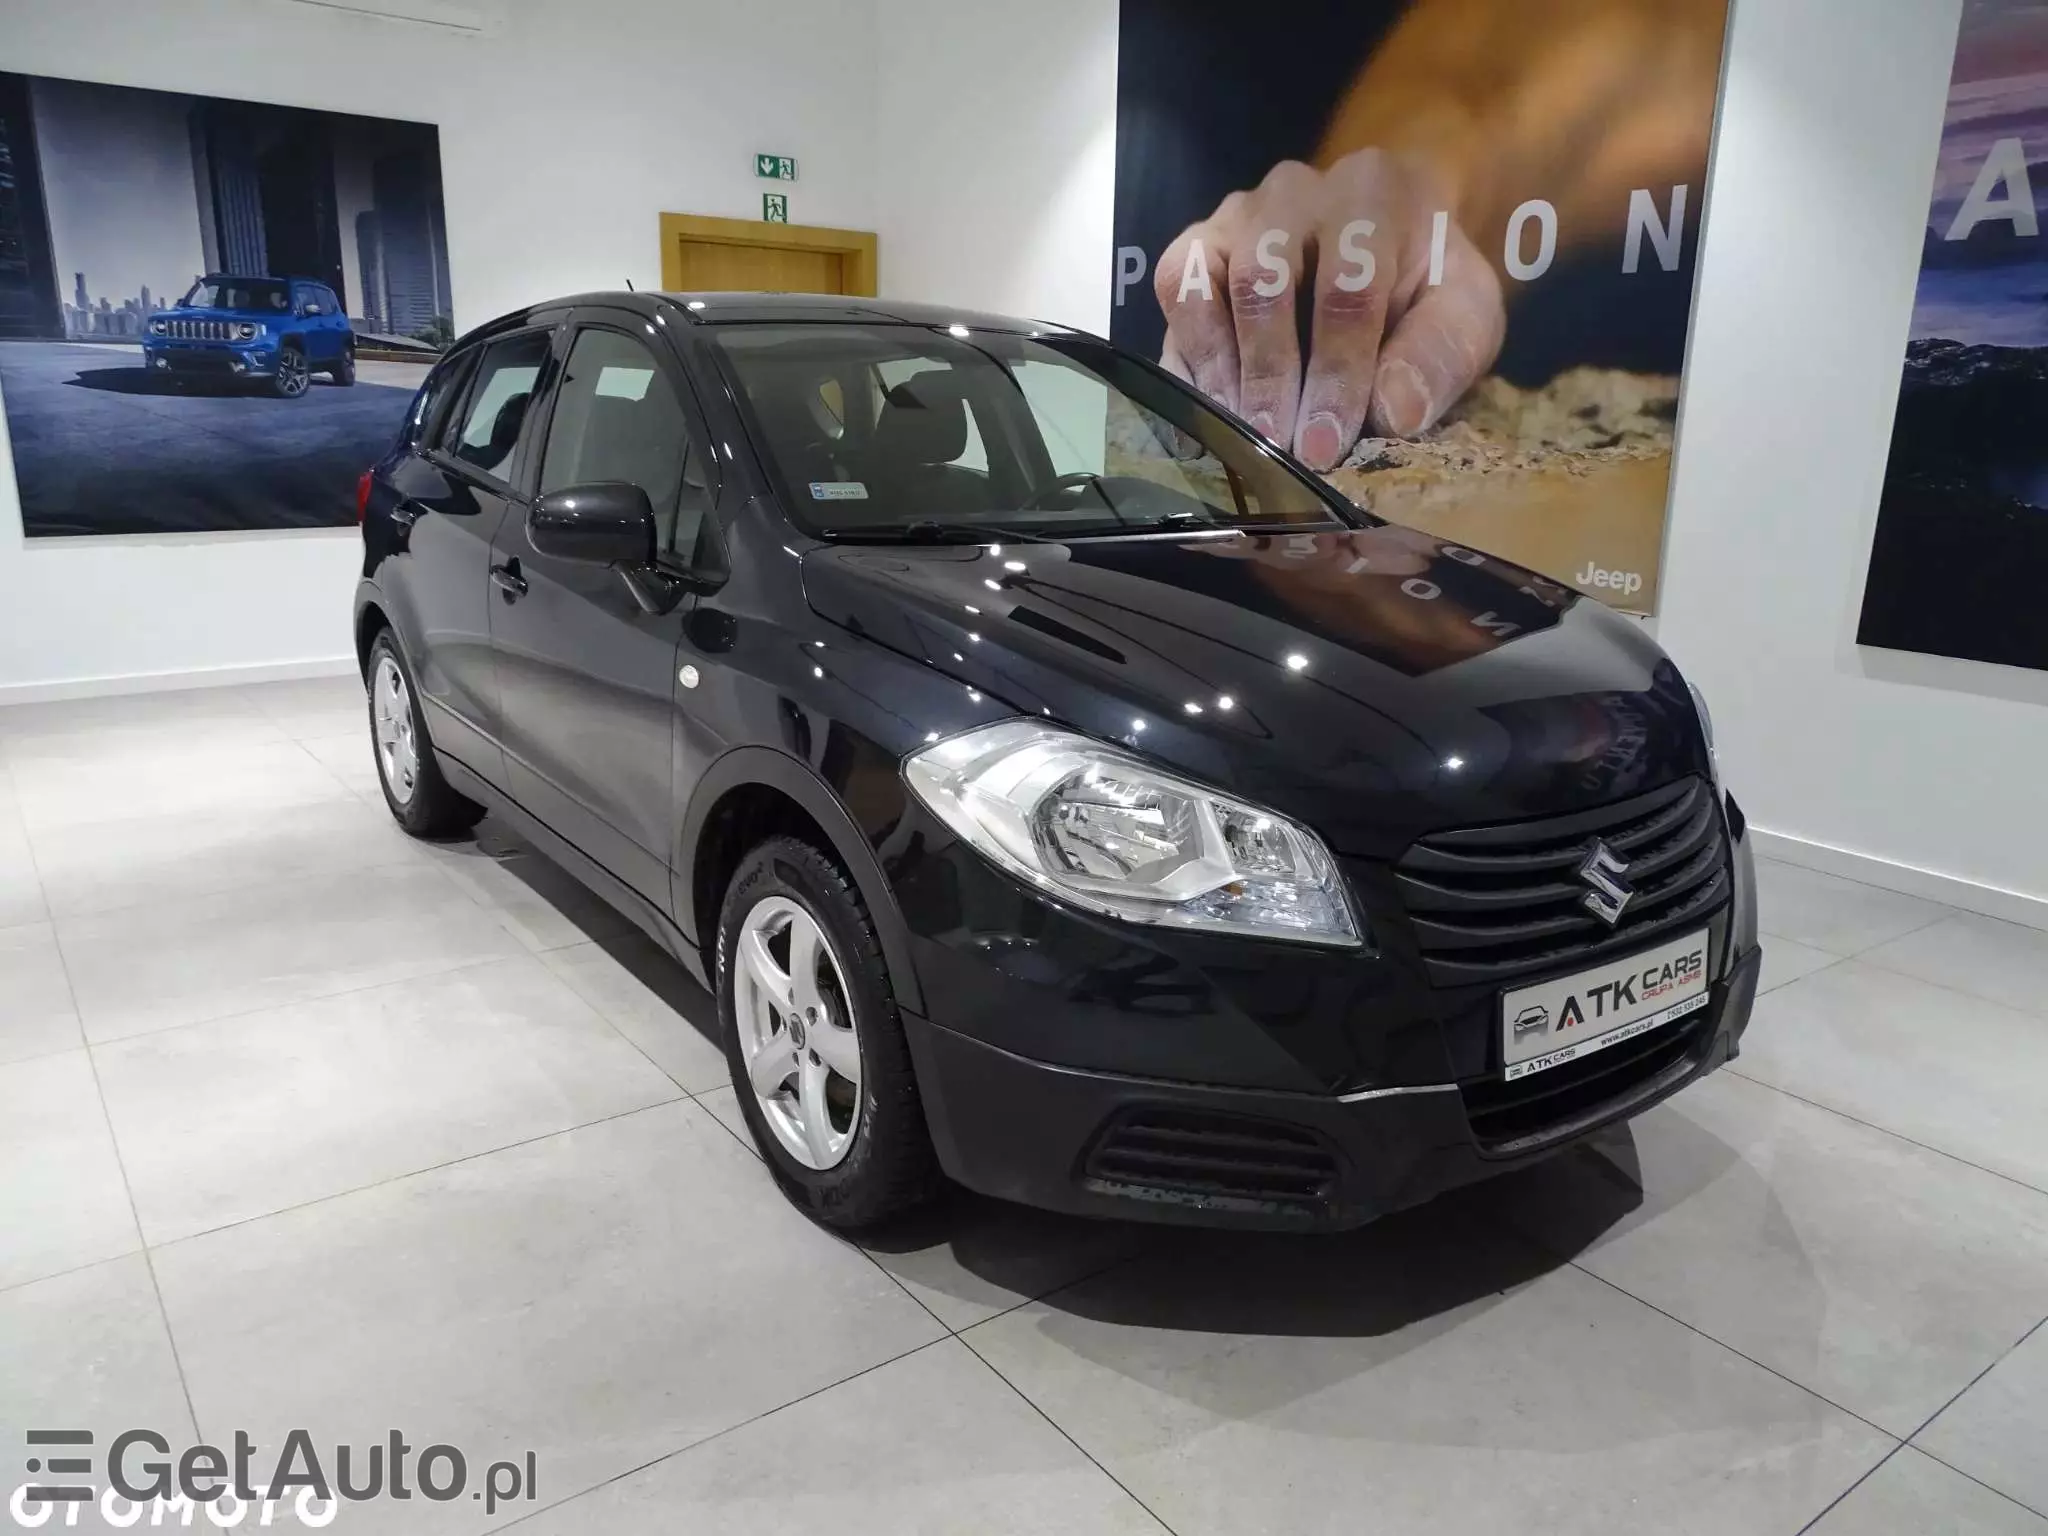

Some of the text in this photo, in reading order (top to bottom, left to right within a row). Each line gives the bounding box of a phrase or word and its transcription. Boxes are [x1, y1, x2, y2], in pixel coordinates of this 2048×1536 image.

[1944, 136, 2040, 240] A
[1114, 184, 1688, 307] PASSION
[1575, 560, 1642, 595] Jeep
[1555, 950, 1702, 1032] ATK CARS
[1527, 1055, 1552, 1073] ATK
[1553, 1047, 1576, 1061] CARS
